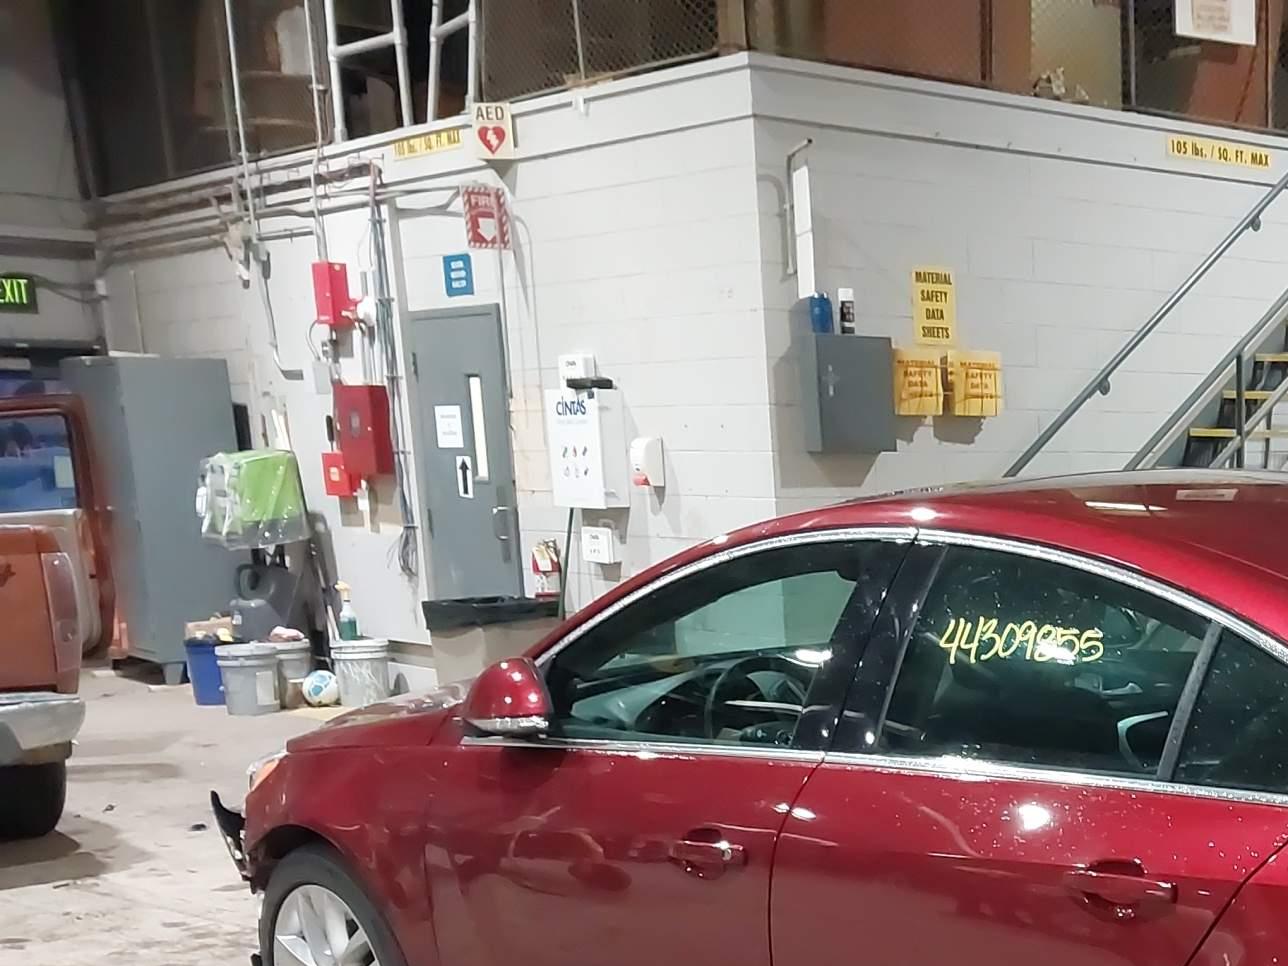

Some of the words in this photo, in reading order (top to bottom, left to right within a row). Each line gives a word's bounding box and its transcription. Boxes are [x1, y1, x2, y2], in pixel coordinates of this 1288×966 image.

[475, 105, 505, 121] AED
[1171, 139, 1188, 154] 105
[1191, 141, 1207, 158] lbs.
[1211, 144, 1215, 159] /
[1218, 146, 1231, 162] SQ.
[1235, 150, 1247, 164] FT.
[1251, 152, 1269, 166] MAX
[915, 271, 952, 285] MATERIAL
[920, 289, 948, 304] SAFETY
[925, 308, 945, 321] DATA
[921, 326, 950, 339] SHEETS
[939, 615, 1104, 665] 44309855
